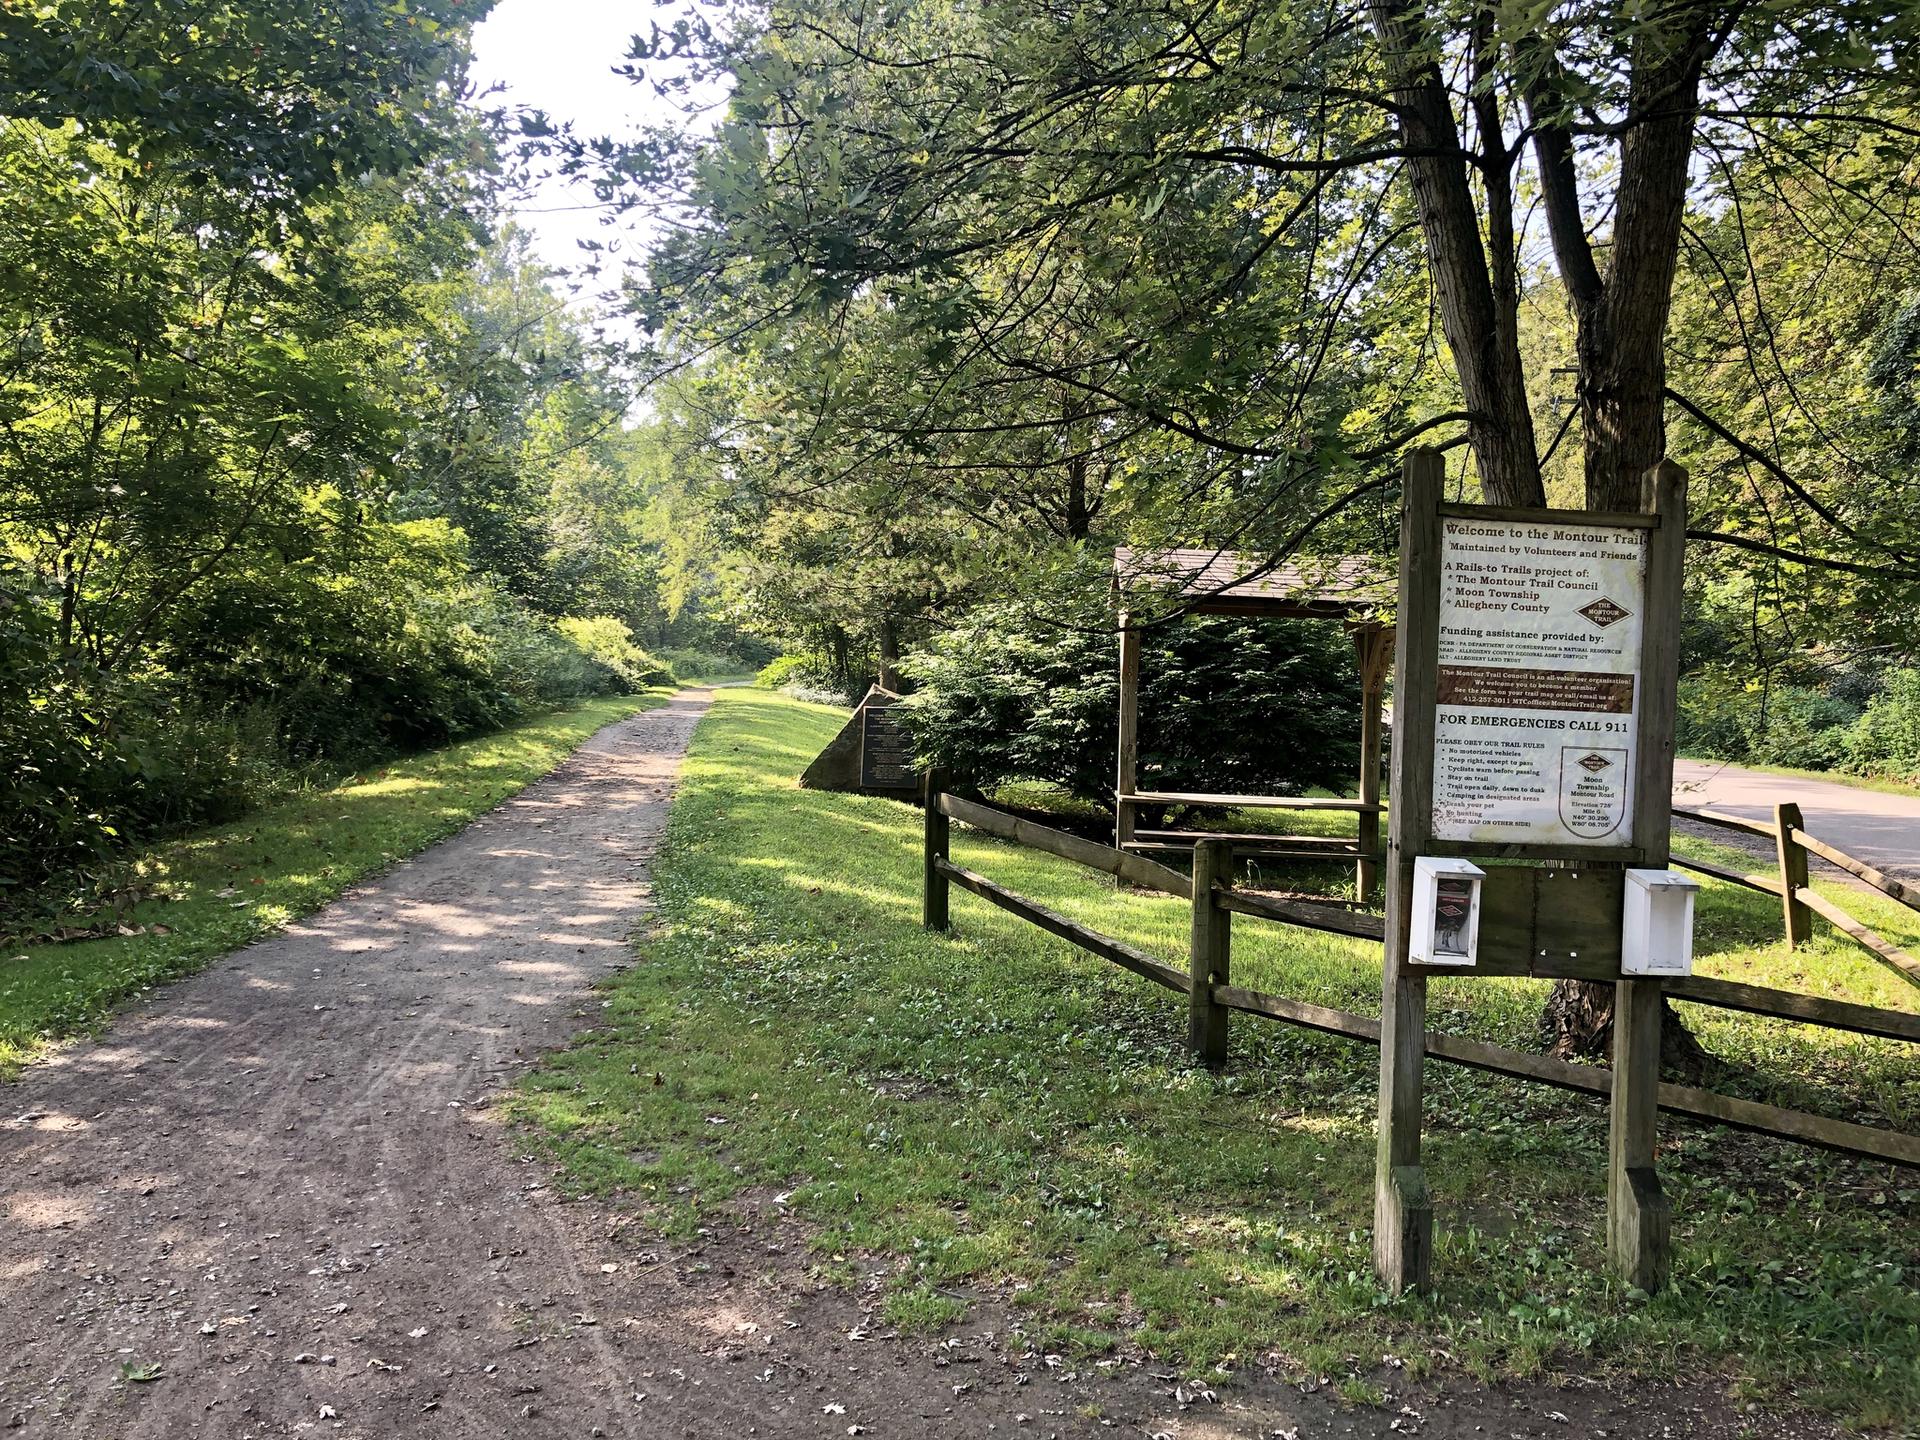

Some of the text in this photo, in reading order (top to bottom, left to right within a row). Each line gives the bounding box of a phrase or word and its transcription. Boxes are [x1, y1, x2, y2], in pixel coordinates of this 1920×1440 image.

[1446, 524, 1643, 545] Welcome to the Montour Trail
[1450, 542, 1506, 553] Maintained
[1509, 546, 1520, 556] by
[1524, 546, 1576, 556] Volunteers
[1600, 550, 1637, 560] Friends
[1444, 562, 1590, 578] A Rails-to Trails project of:
[1456, 575, 1598, 590] The Montour Trail Council
[1456, 588, 1540, 601] Moon Township
[1454, 600, 1550, 614] Allegheny County
[1440, 627, 1604, 644] Funding assistance provided by:
[1440, 714, 1628, 732] FOR EMERGENCIES CALL 911
[1576, 784, 1609, 792] Township
